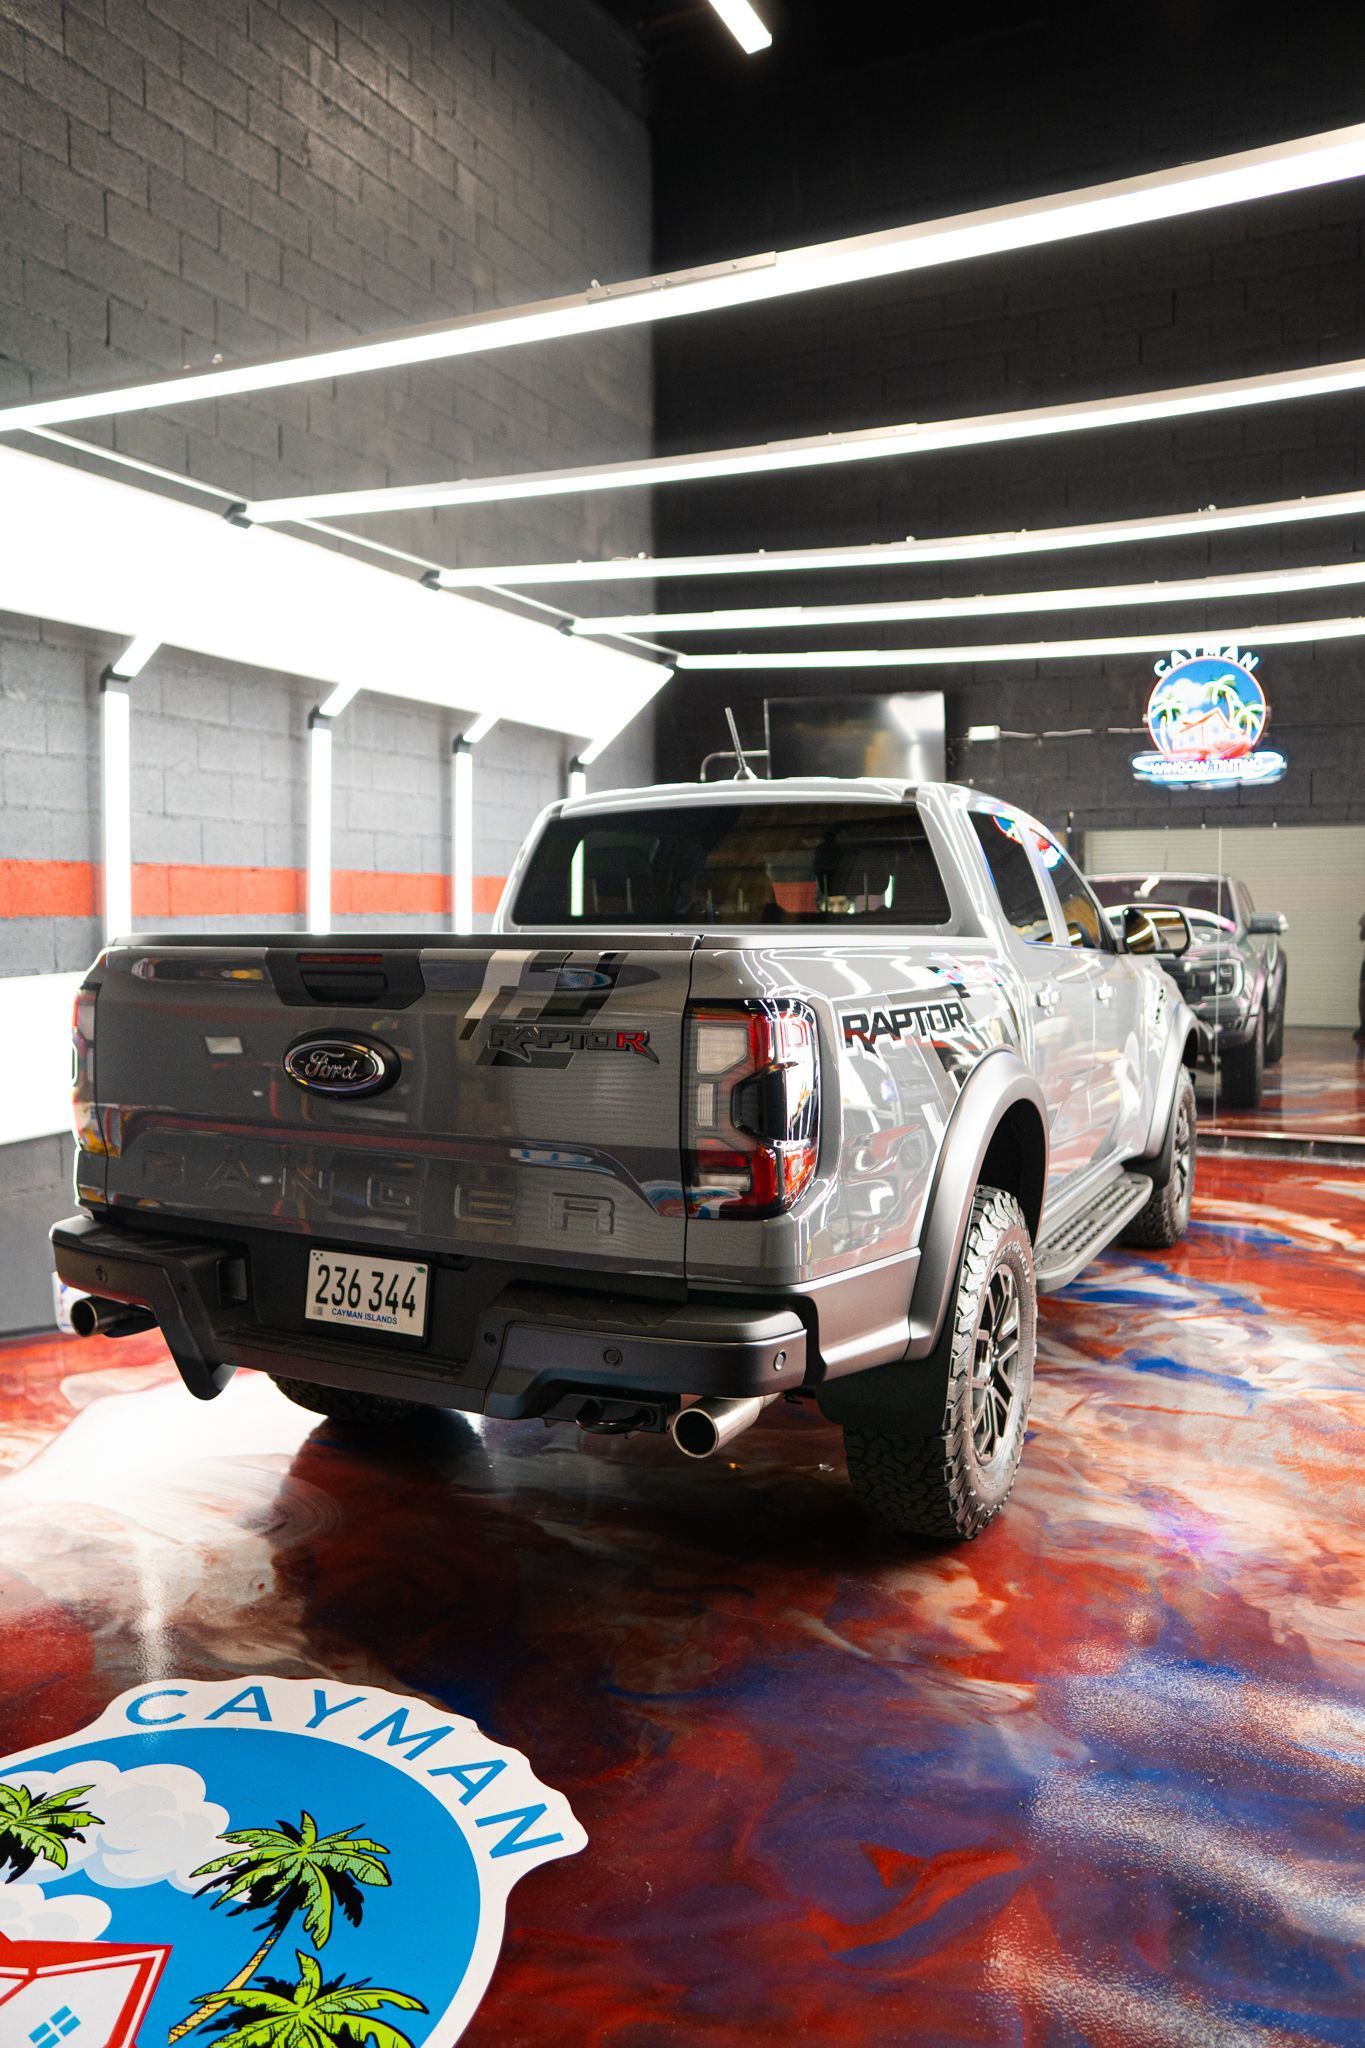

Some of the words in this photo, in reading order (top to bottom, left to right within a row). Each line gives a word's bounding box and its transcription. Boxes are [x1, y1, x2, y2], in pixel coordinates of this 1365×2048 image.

[1154, 646, 1259, 677] CAYMAN
[1150, 760, 1210, 775] WINDOW
[1212, 757, 1262, 772] TINTING
[488, 1024, 660, 1065] RAPTOR
[841, 1001, 967, 1058] RAPTOR
[304, 1050, 358, 1080] Ford
[142, 1149, 616, 1236] RANGER
[315, 1264, 361, 1309] 236
[368, 1271, 416, 1318] 344
[331, 1307, 363, 1320] CAYMAN
[364, 1313, 398, 1325] ISLANDS
[125, 1685, 565, 1860] CAYMAN
